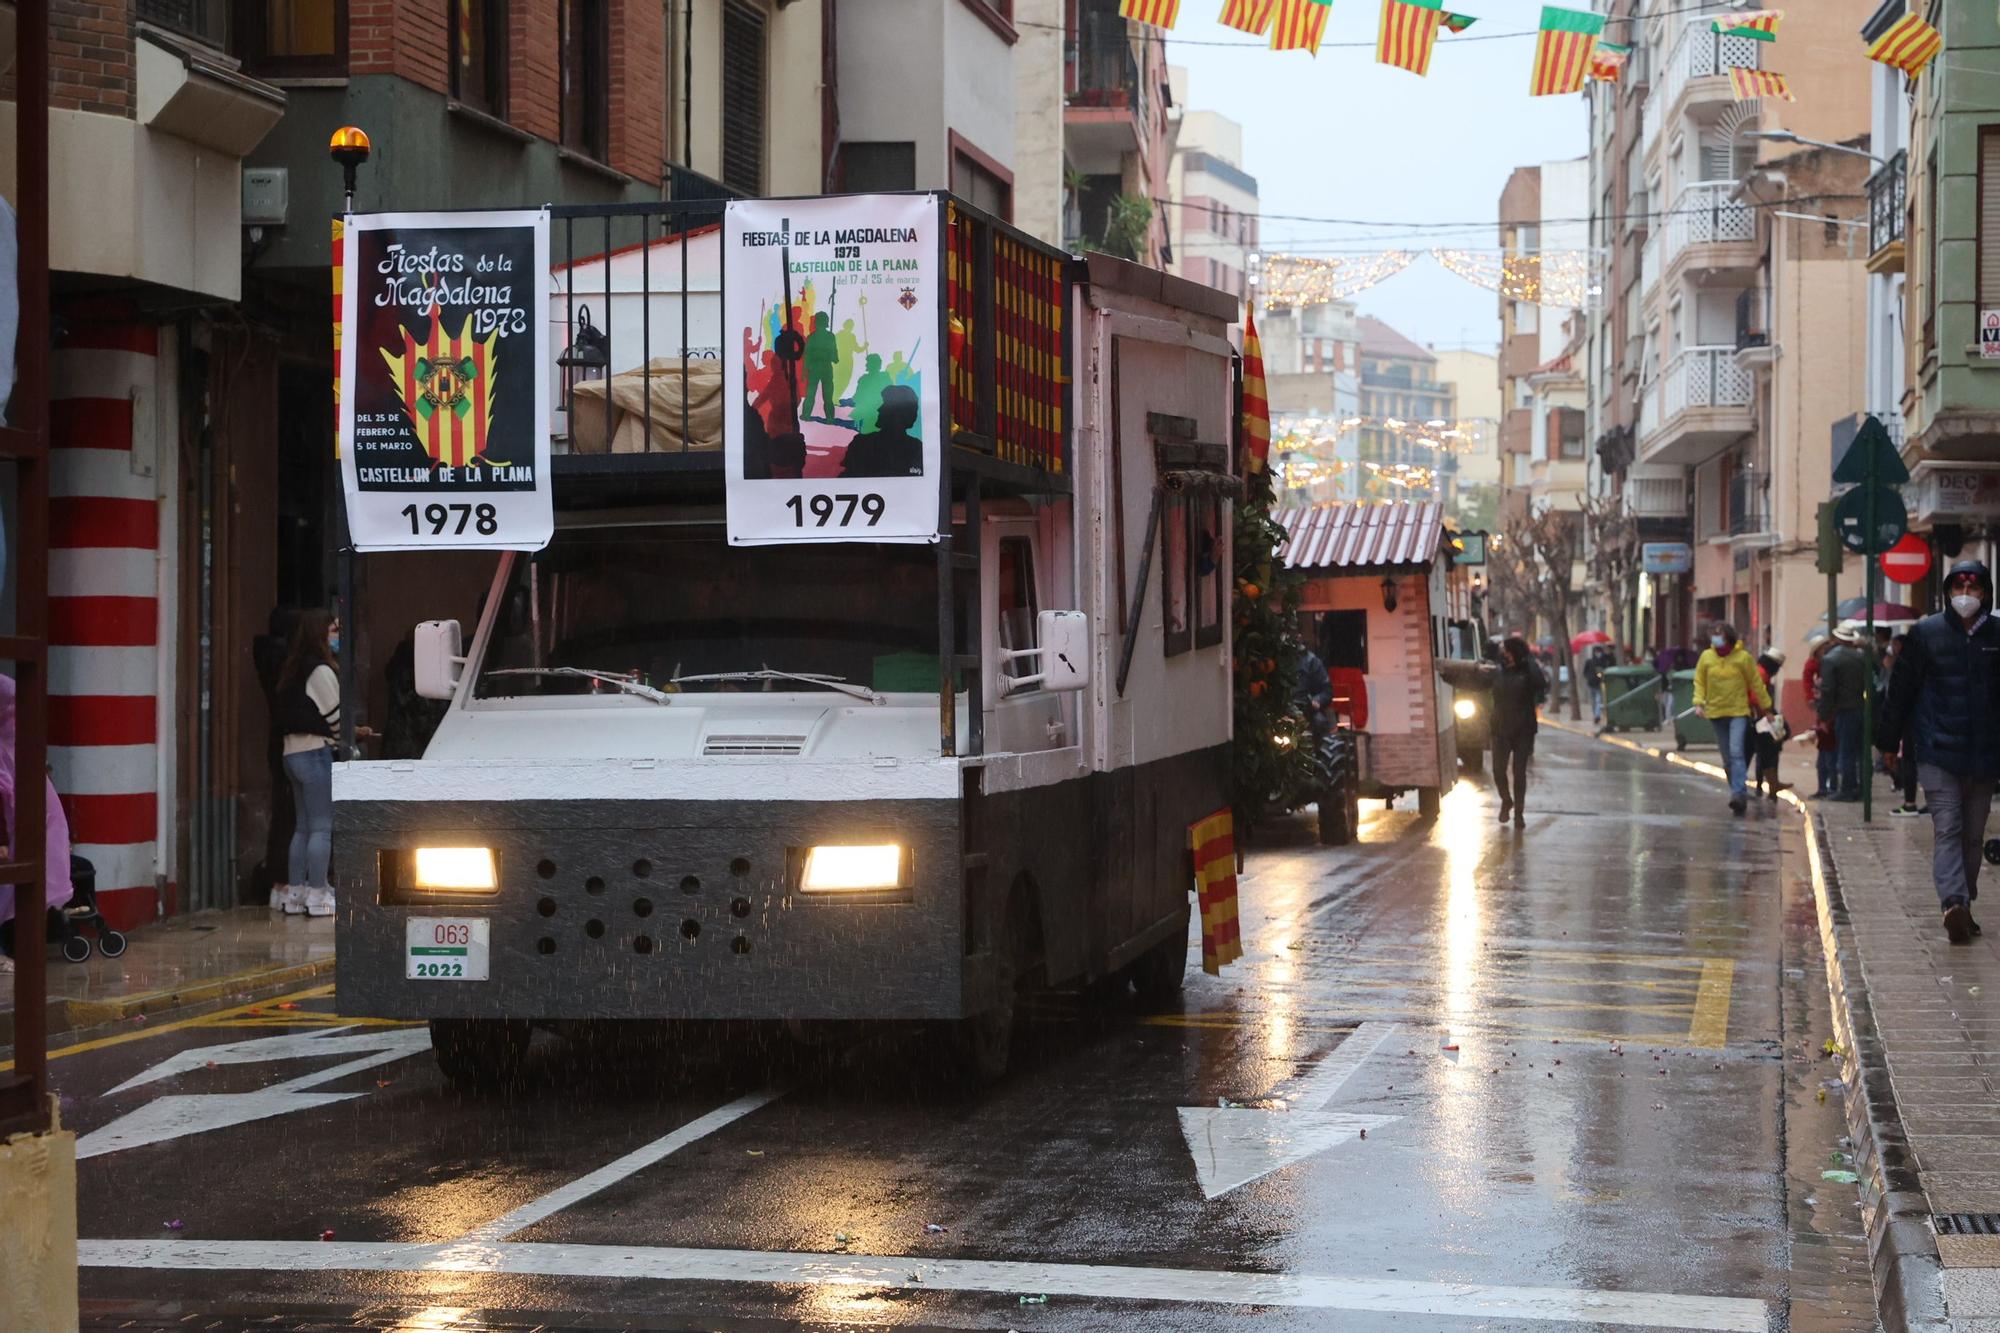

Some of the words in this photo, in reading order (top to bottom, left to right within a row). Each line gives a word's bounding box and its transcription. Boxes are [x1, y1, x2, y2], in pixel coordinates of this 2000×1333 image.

[742, 231, 790, 247] FIESTAS
[794, 231, 811, 246] DE
[814, 230, 831, 246] LA
[835, 228, 918, 244] MAGDALENA
[377, 243, 464, 274] Fiestas
[476, 254, 494, 272] de
[497, 253, 513, 272] la
[834, 246, 860, 259] 1979
[789, 260, 845, 273] CASTELLON
[848, 260, 862, 272] DE
[866, 259, 879, 271] LA
[883, 258, 919, 271] PLANA
[836, 274, 848, 285] del
[850, 274, 858, 285] 17
[374, 276, 512, 317] Magdalena
[473, 307, 527, 338] 1978
[357, 413, 373, 422] DEL
[375, 413, 386, 421] 25
[388, 413, 400, 421] DE
[356, 428, 396, 436] FEBRERO
[399, 428, 410, 436] AL
[356, 442, 364, 450] 5
[366, 442, 377, 450] DE
[380, 442, 413, 450] MARZO
[359, 467, 431, 483] CASTELLON
[439, 467, 456, 483] DE
[465, 467, 482, 483] LA
[492, 466, 533, 483] PLANA
[785, 493, 886, 527] 1979
[401, 503, 498, 536] 1978
[435, 924, 469, 944] 063
[417, 963, 463, 977] 2022
